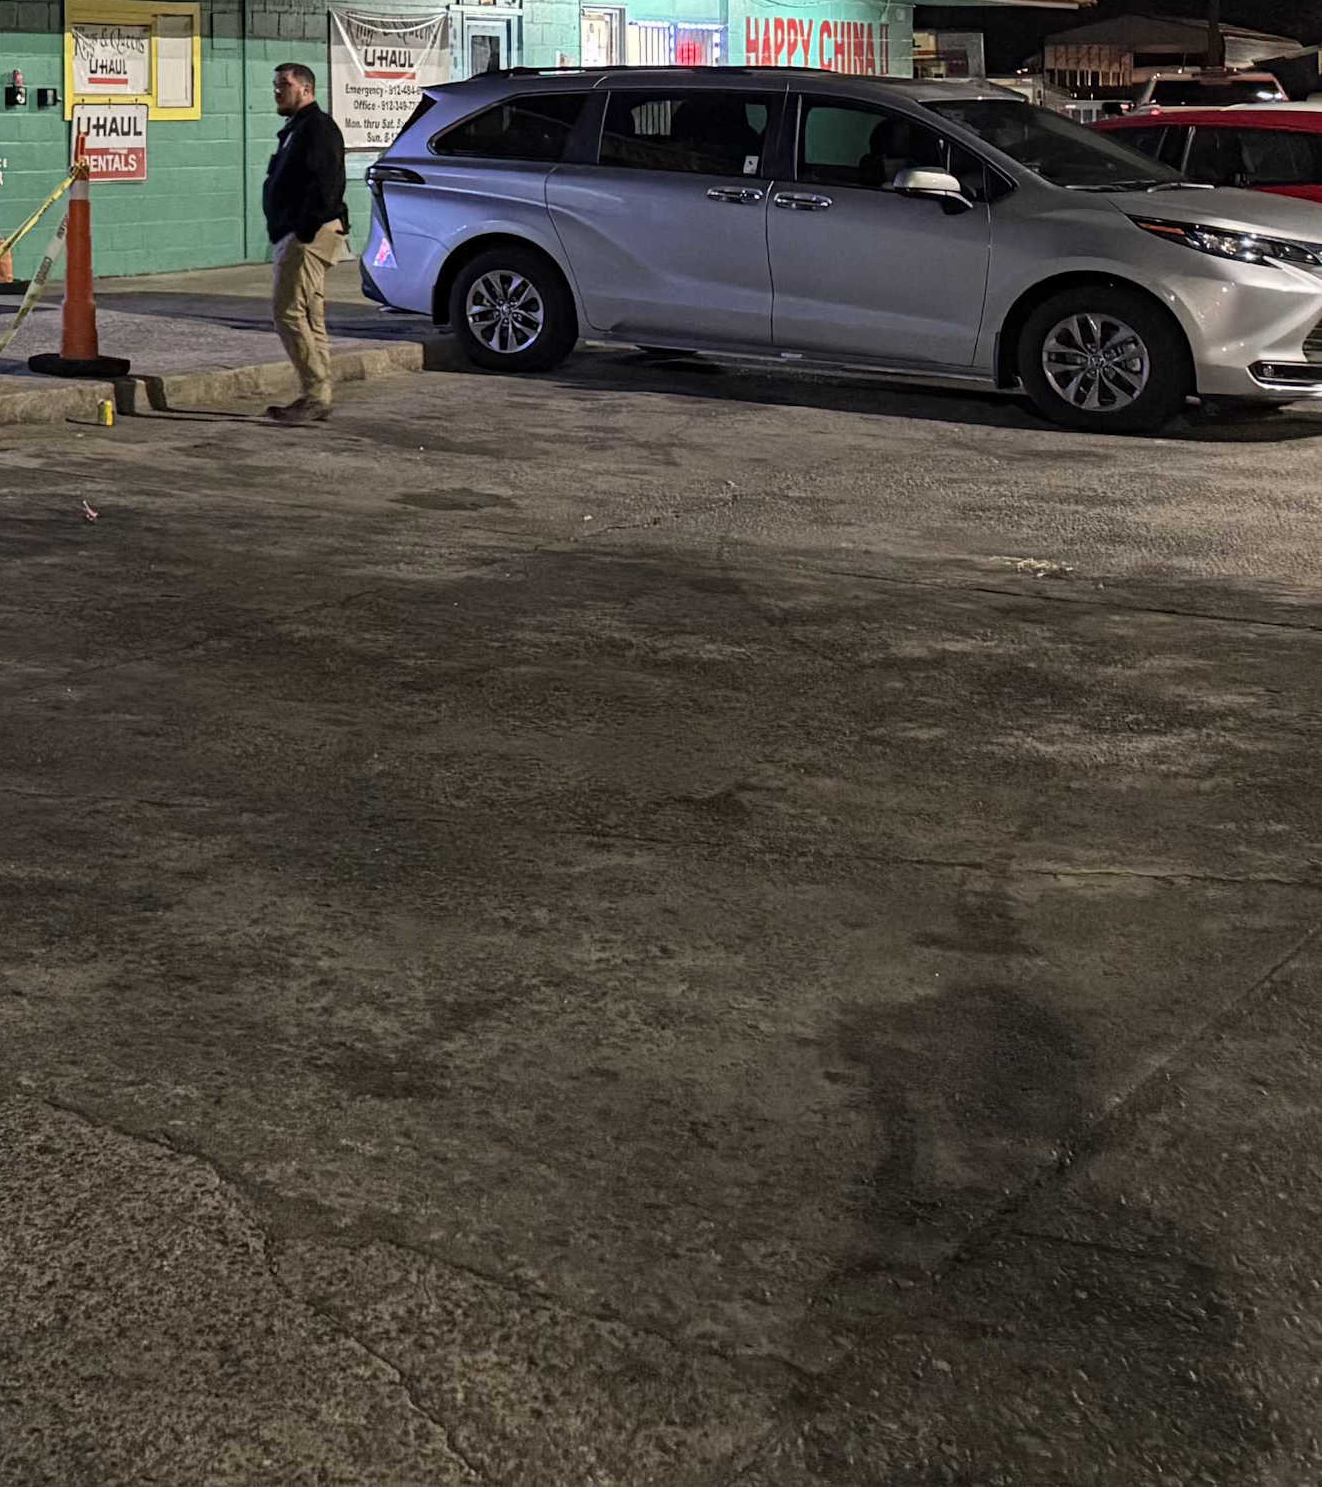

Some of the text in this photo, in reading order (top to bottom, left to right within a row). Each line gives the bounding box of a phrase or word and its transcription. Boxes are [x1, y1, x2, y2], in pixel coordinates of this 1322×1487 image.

[746, 16, 813, 66] HAPPY
[819, 19, 877, 75] CHINA
[89, 58, 128, 75] U-HAUL
[364, 48, 415, 68] U-HAUL
[344, 83, 384, 98] Emergency
[353, 100, 377, 111] Office
[76, 116, 143, 137] U-HAUL
